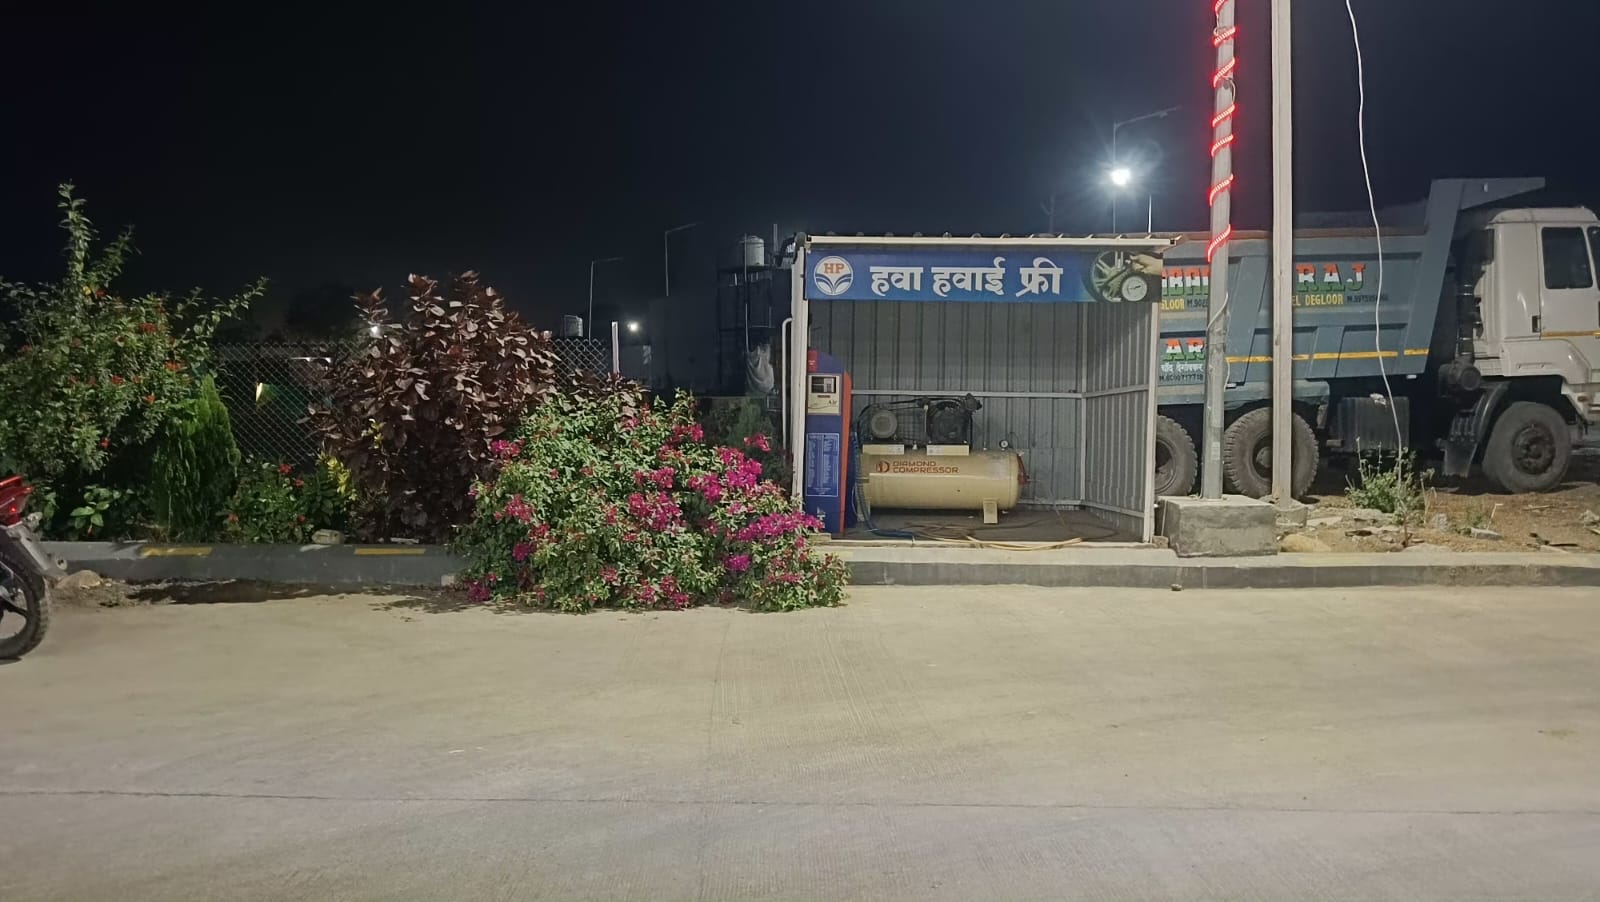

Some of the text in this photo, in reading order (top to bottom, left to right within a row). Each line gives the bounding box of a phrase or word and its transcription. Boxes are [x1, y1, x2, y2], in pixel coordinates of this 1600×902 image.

[822, 262, 846, 275] HP
[869, 256, 1064, 298] हवा हवाई फ्री
[1295, 262, 1367, 293] RAJ
[1305, 293, 1345, 306] DEGLOOR
[892, 466, 960, 474] COMPRESSOR
